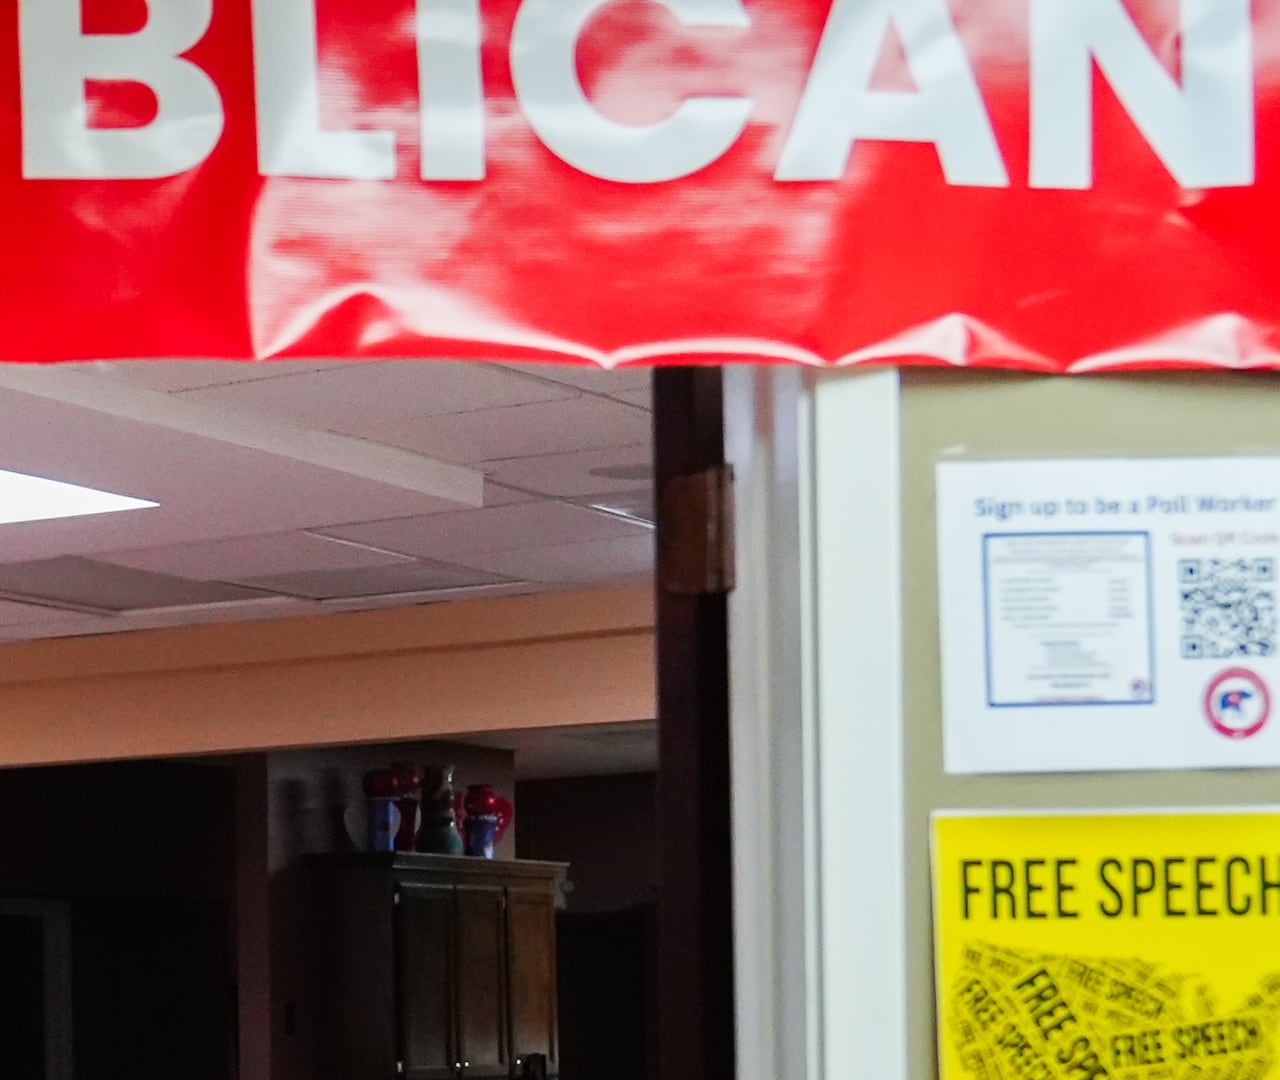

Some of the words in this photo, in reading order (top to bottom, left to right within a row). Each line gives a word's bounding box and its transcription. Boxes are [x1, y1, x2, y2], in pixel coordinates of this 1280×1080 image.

[974, 497, 1022, 520] Sign
[1030, 500, 1057, 518] up
[1065, 498, 1085, 515] to
[1095, 497, 1120, 515] be
[1146, 496, 1188, 514] Poll
[1196, 496, 1276, 513] Worker
[961, 858, 1079, 920] FREE
[1098, 856, 1280, 918] SPEECH
[1015, 968, 1077, 1041] FREE
[1110, 1029, 1165, 1068] FREE
[1172, 1018, 1261, 1060] SPEECH
